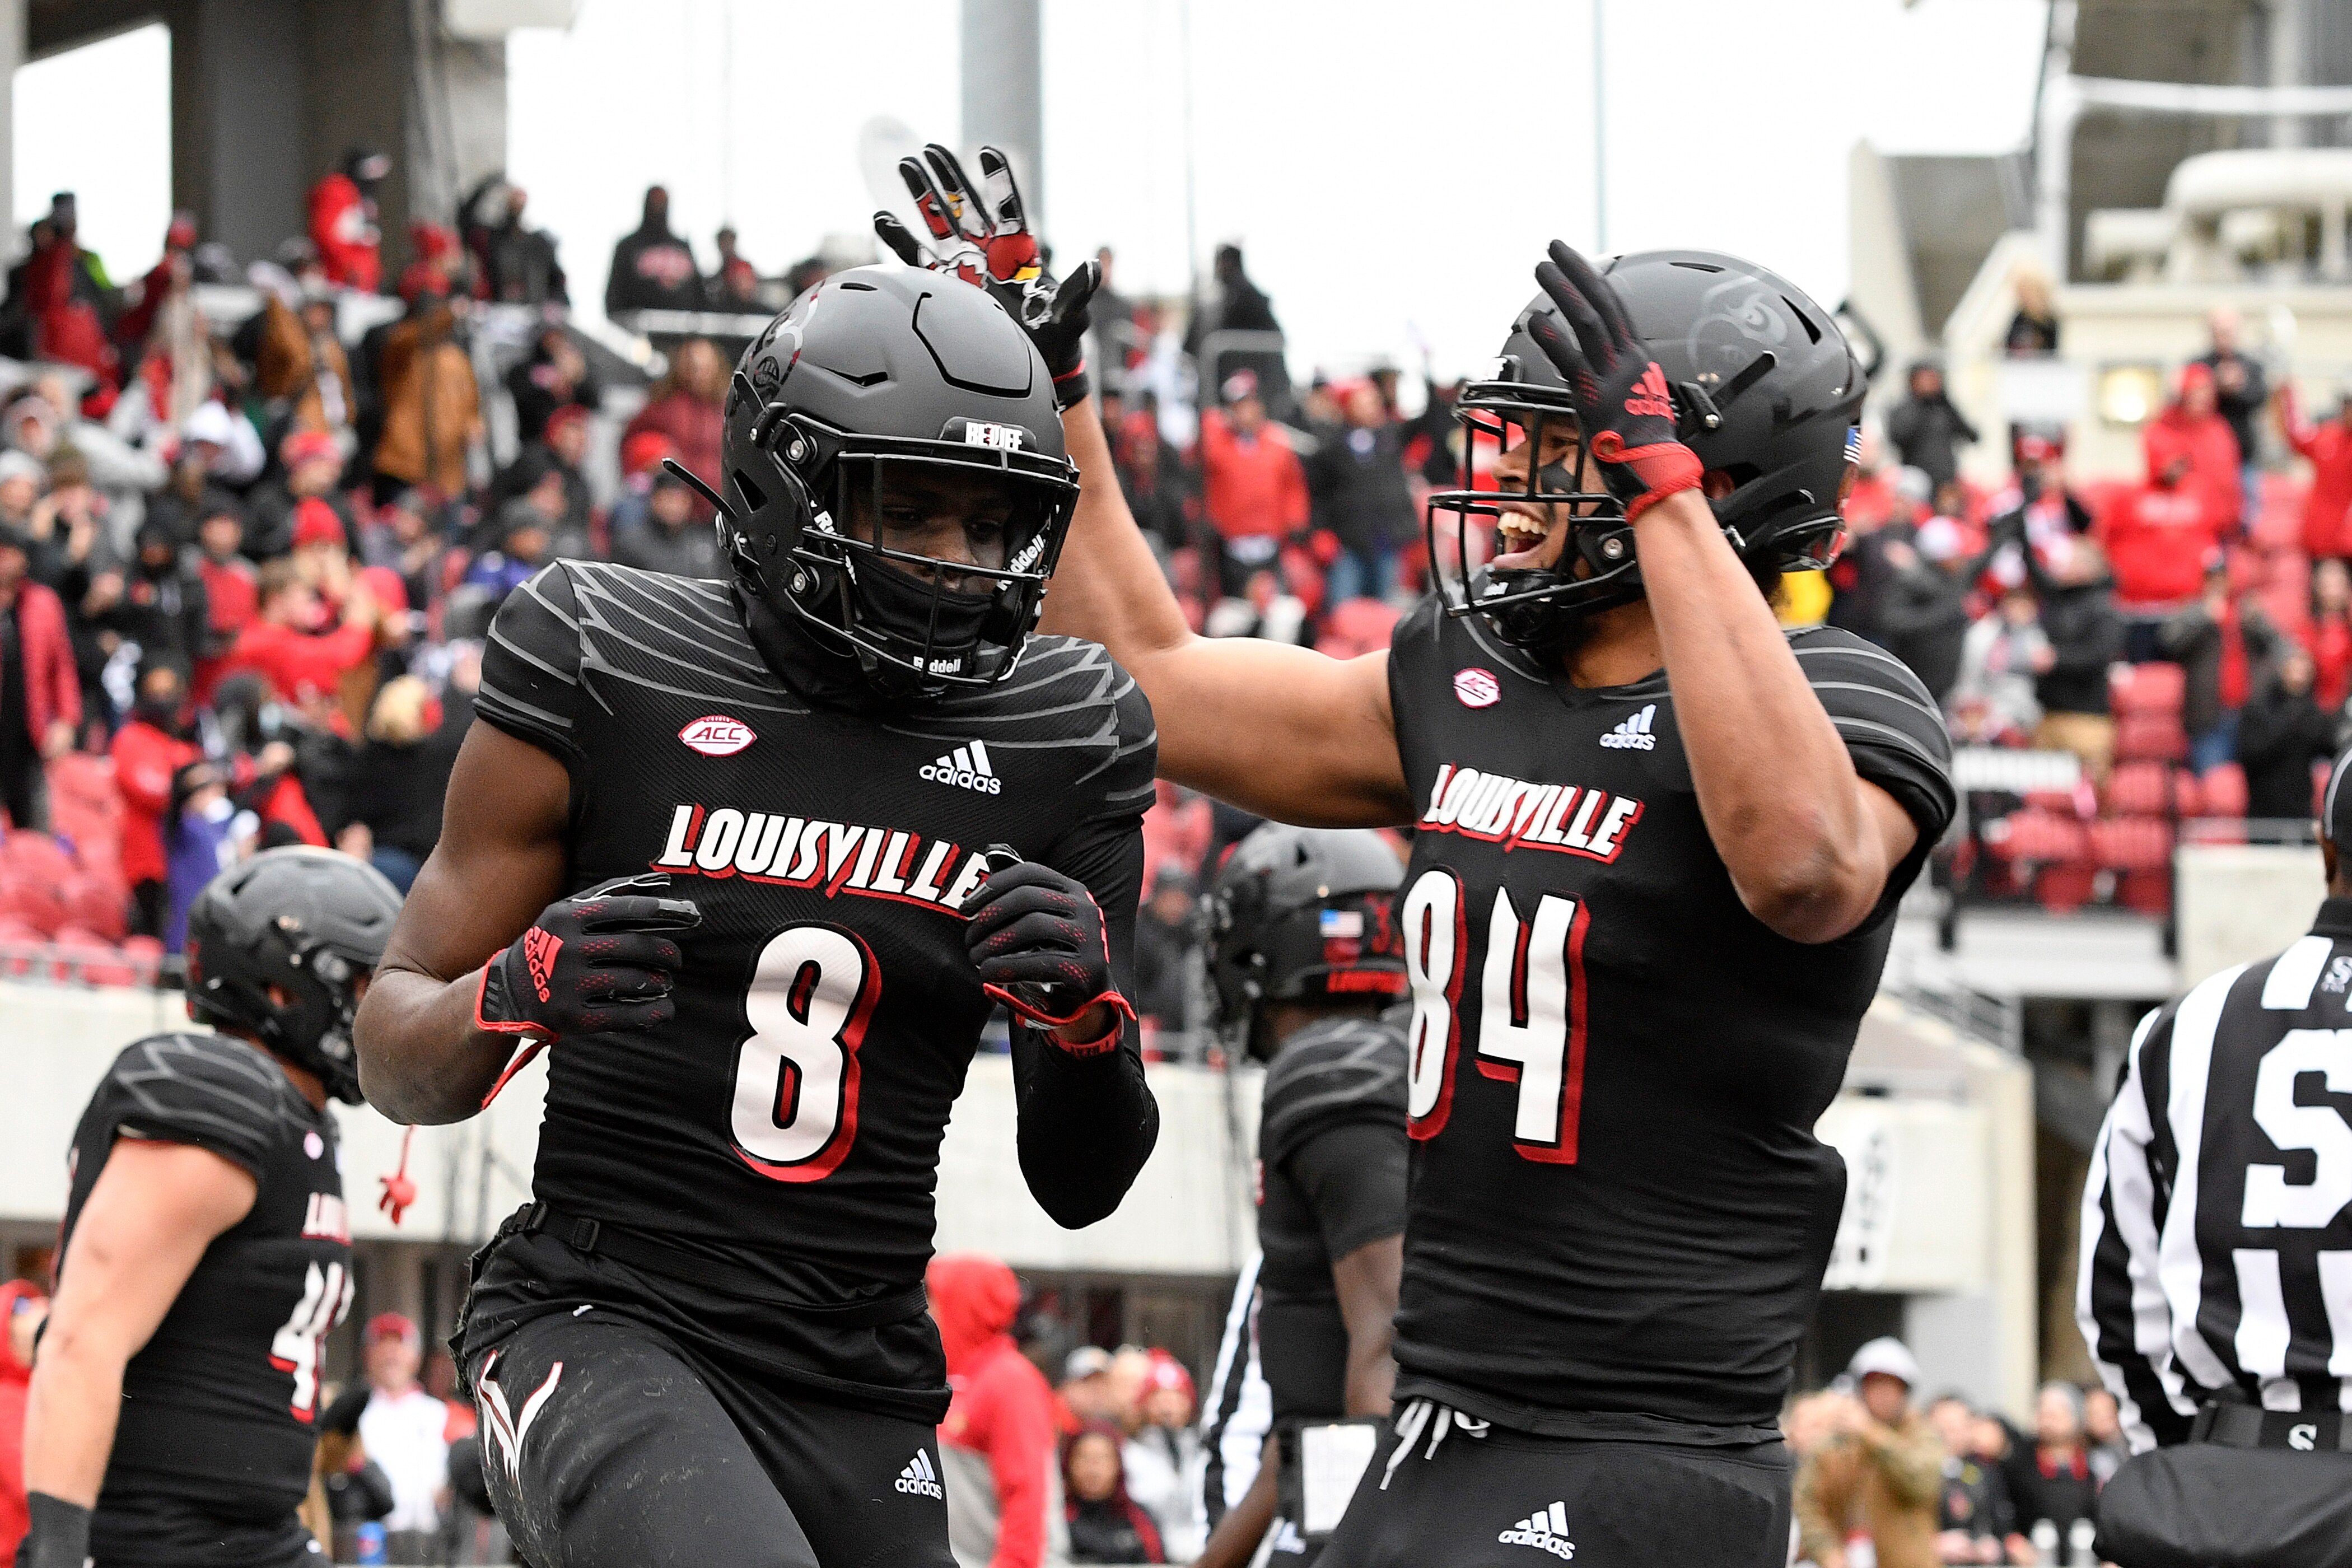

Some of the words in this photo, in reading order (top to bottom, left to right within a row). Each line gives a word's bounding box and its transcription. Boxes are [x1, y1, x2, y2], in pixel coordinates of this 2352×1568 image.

[913, 656, 962, 673] Rddell
[690, 726, 746, 740] ACC
[919, 764, 1001, 795] adidas
[1417, 763, 1645, 865] LOUISVILLE
[650, 802, 991, 920] LOUISVILLE
[1402, 869, 1590, 1165] 84
[729, 924, 882, 1183] 8
[2242, 1027, 2352, 1229] S
[894, 1476, 942, 1500] adidas
[1498, 1529, 1576, 1560] adidas
